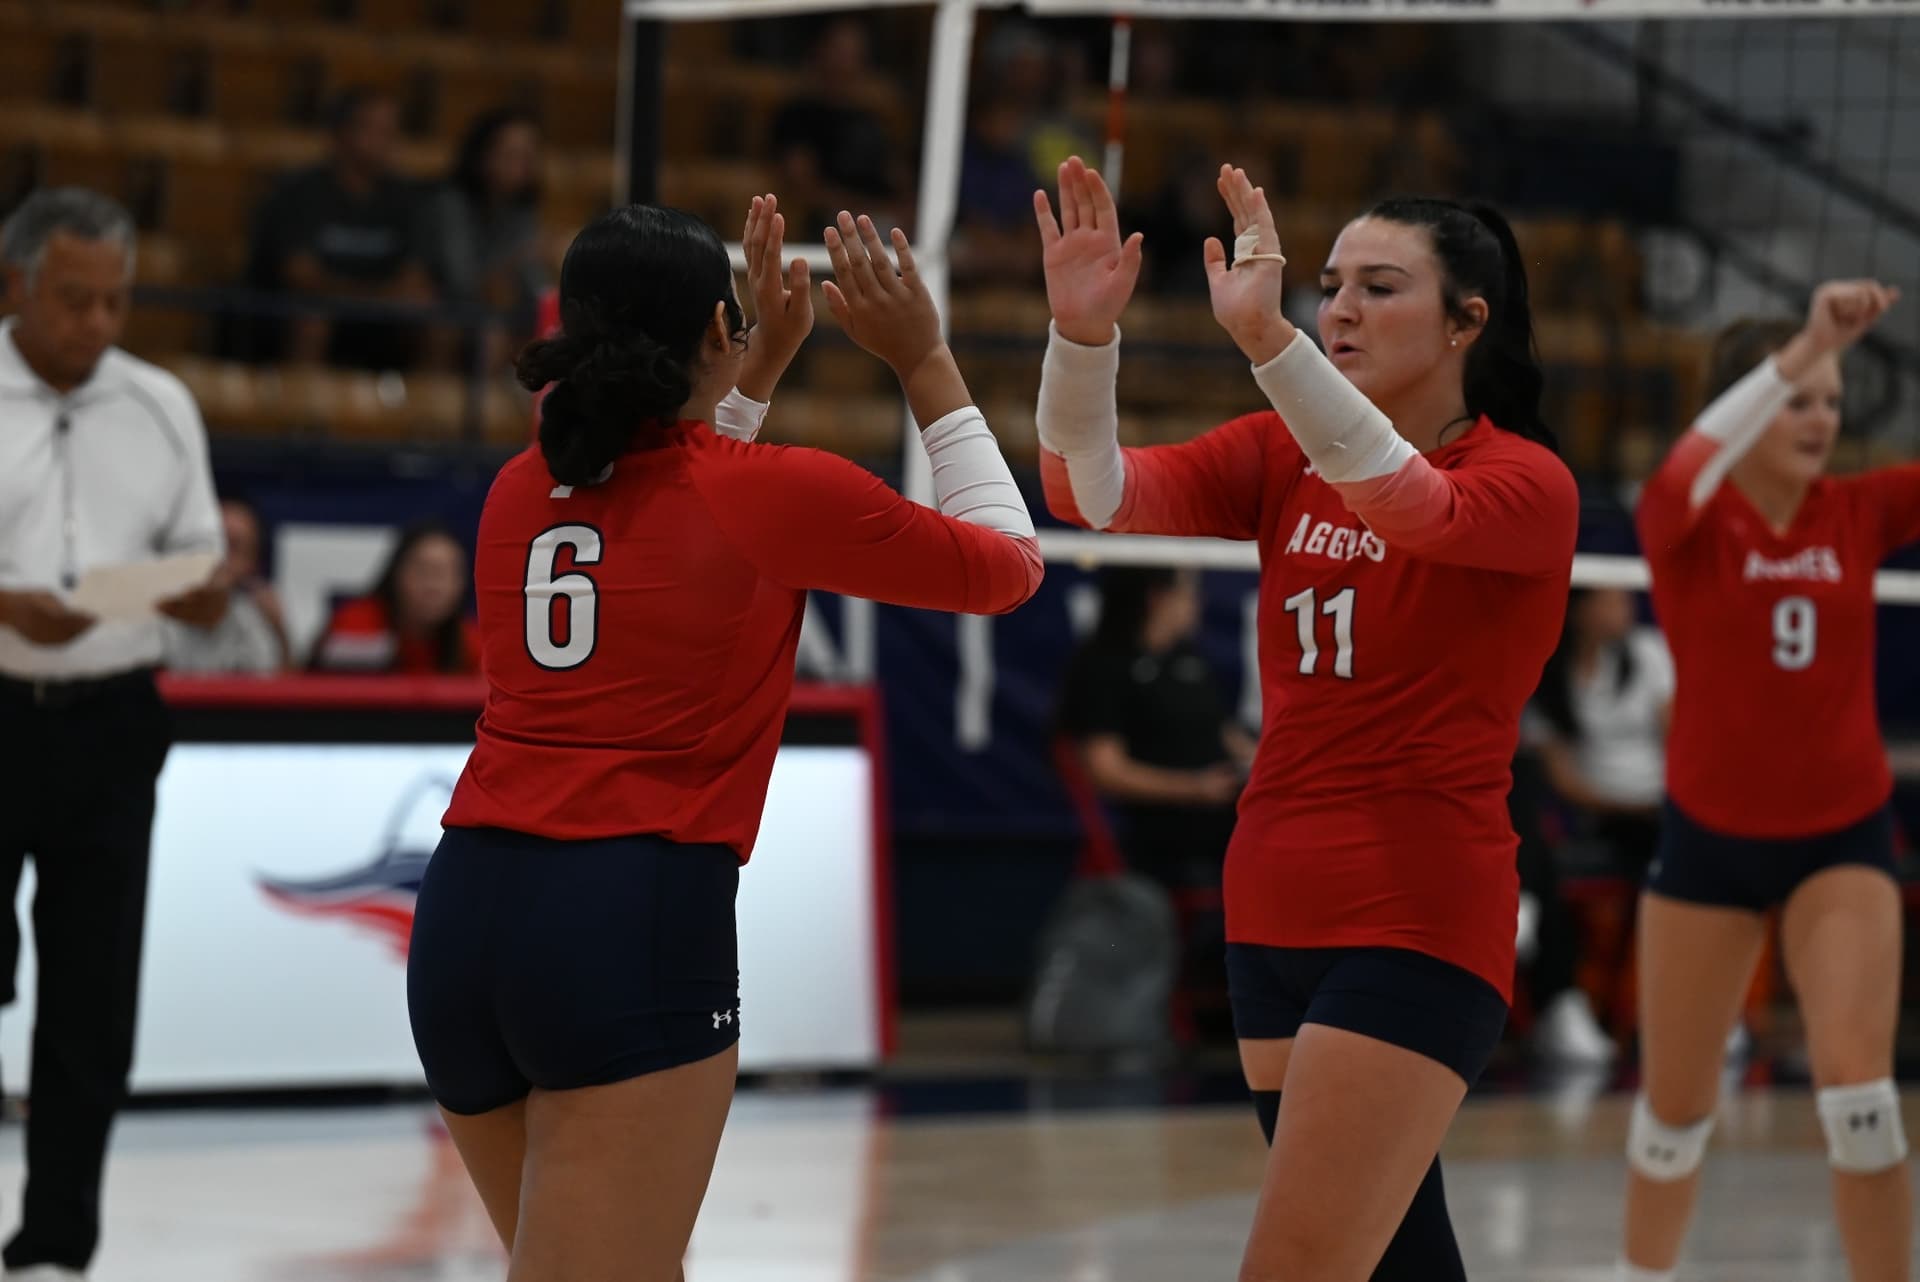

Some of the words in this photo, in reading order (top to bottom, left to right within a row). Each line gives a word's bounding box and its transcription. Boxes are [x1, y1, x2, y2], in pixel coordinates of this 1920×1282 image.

[524, 521, 603, 671] 6
[1284, 586, 1355, 679] 11
[1771, 595, 1817, 670] 9
